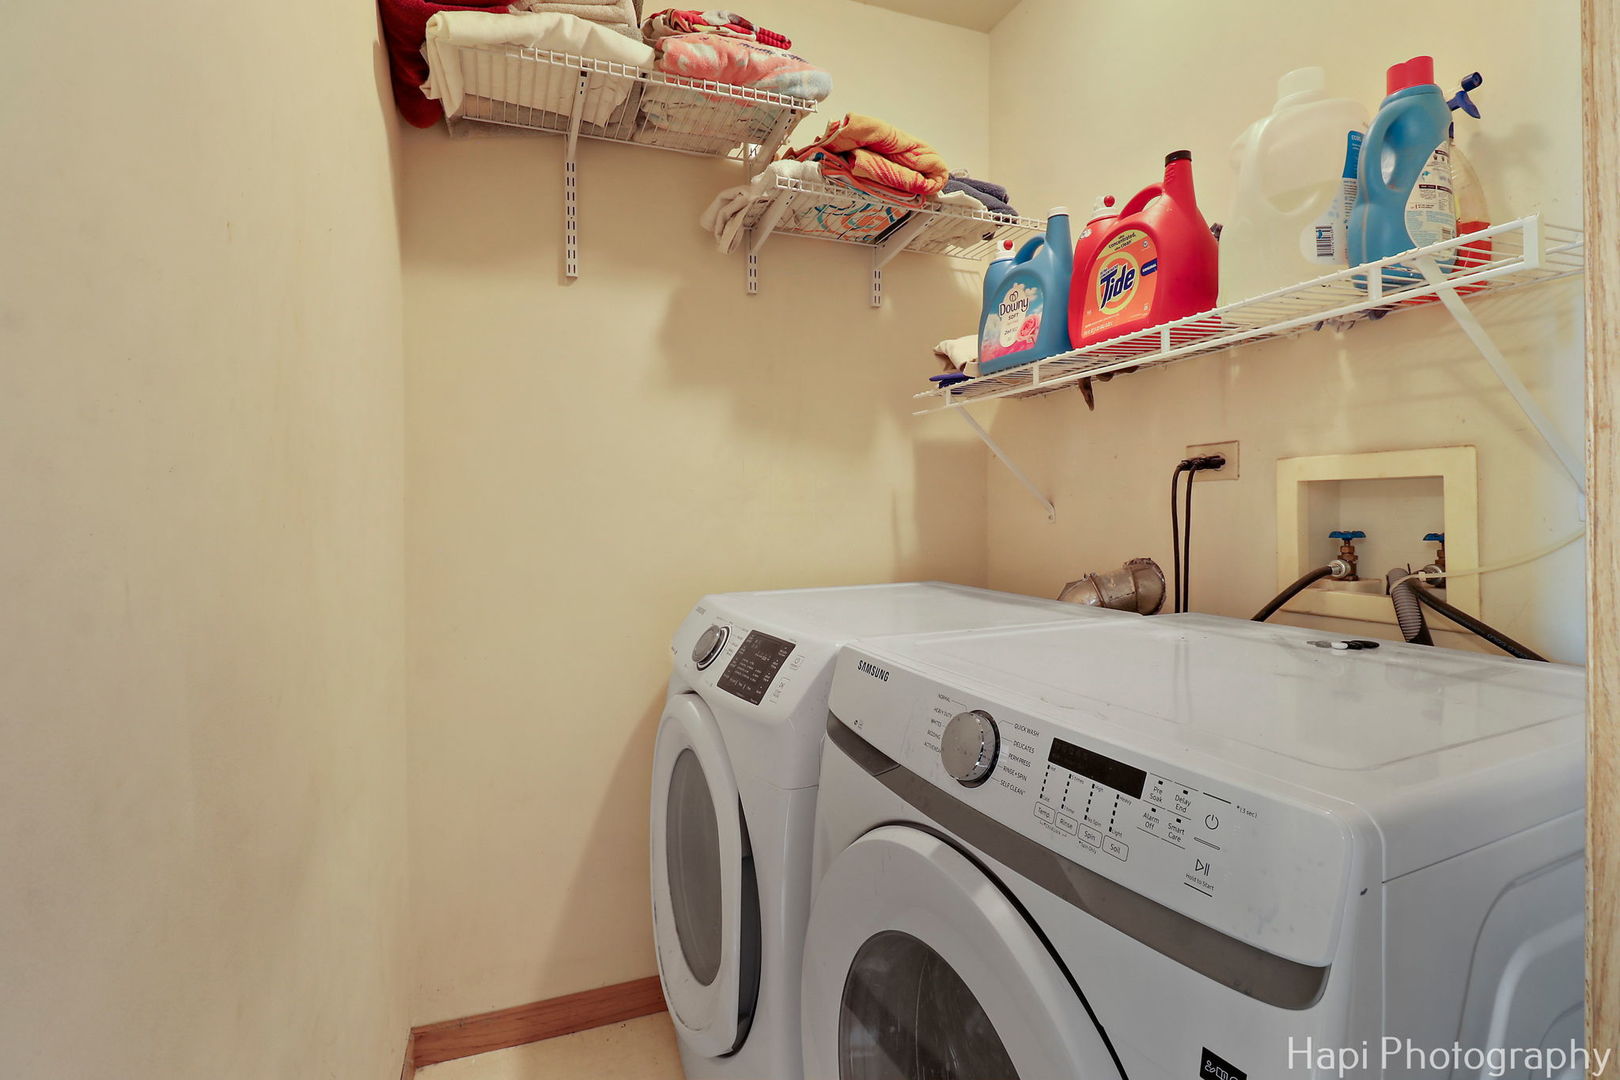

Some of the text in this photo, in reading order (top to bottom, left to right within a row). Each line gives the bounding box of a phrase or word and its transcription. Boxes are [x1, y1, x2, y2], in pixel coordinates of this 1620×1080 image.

[1100, 264, 1136, 309] Tide
[1000, 298, 1029, 316] Downy
[857, 659, 890, 682] SAMSUNG
[1014, 723, 1040, 737] QUICK WASH
[1013, 740, 1035, 754] DELICATES
[1008, 753, 1031, 768] PERM PRESS
[1000, 780, 1010, 788] SELF
[1153, 786, 1163, 795] Pre
[1149, 793, 1163, 803] Soak
[1175, 794, 1191, 807] Delay
[1175, 803, 1187, 813] End
[1060, 818, 1073, 829] Rinse
[1143, 812, 1160, 824] Alarm
[1145, 821, 1155, 830] Off
[1167, 822, 1185, 836] Smart
[1084, 830, 1096, 841] Spin
[1168, 831, 1182, 843] Care
[1110, 843, 1121, 854] Soil
[1185, 872, 1215, 891] Hold to Start
